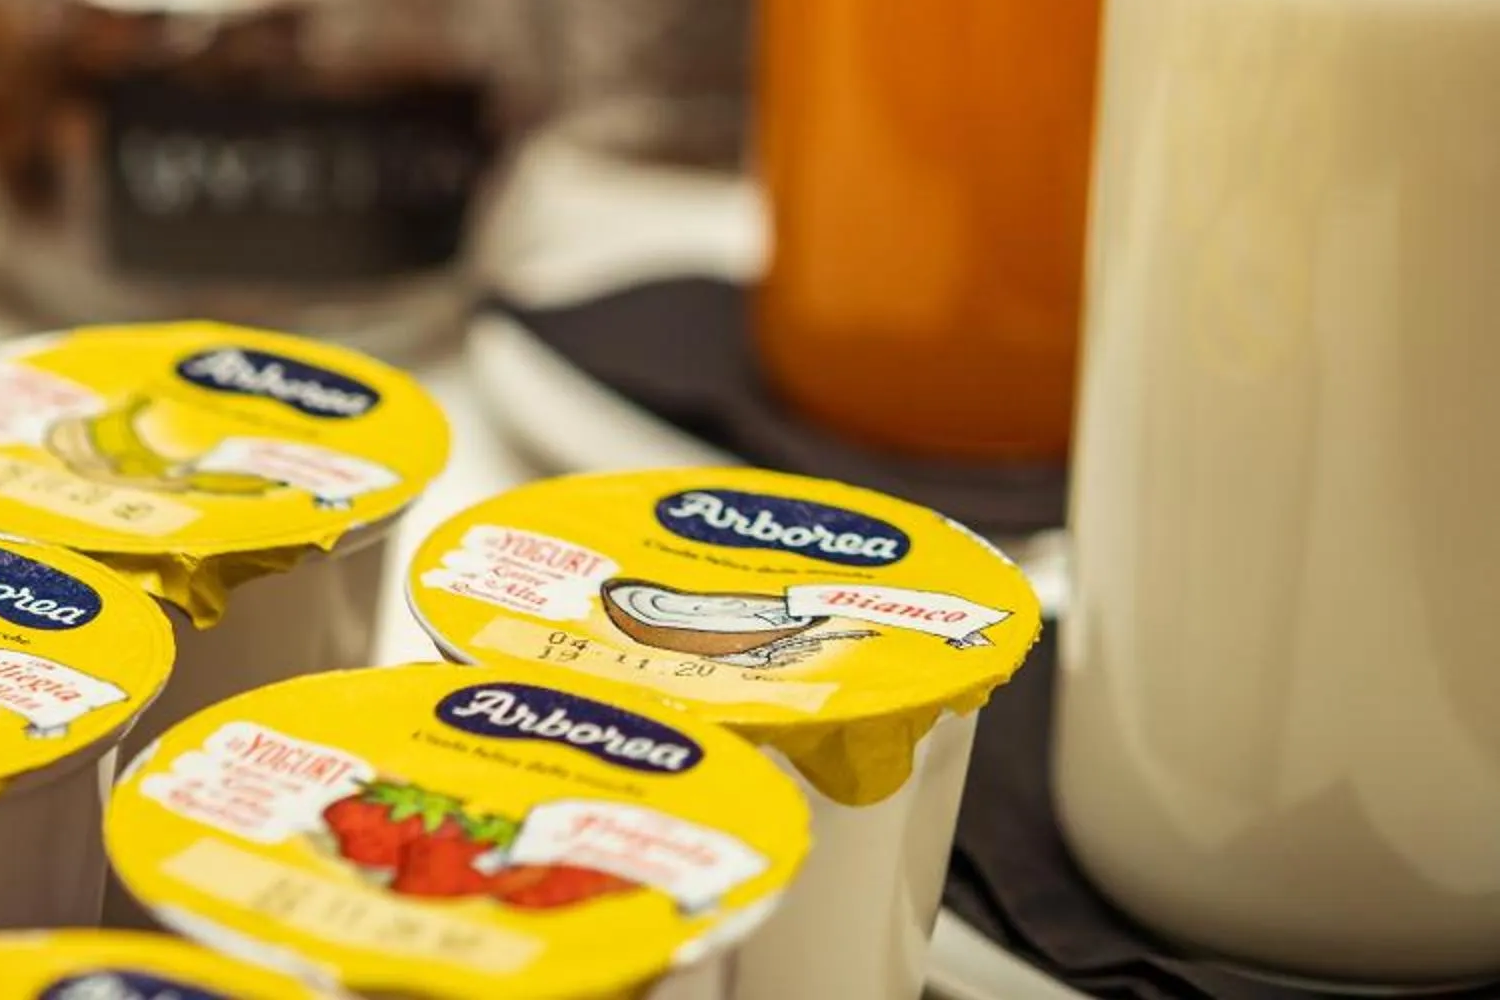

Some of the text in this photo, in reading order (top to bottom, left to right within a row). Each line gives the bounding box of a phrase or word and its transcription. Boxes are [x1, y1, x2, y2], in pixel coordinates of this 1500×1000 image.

[668, 492, 899, 560] Arborea
[819, 589, 969, 625] Bianco
[452, 689, 690, 771] Arborea
